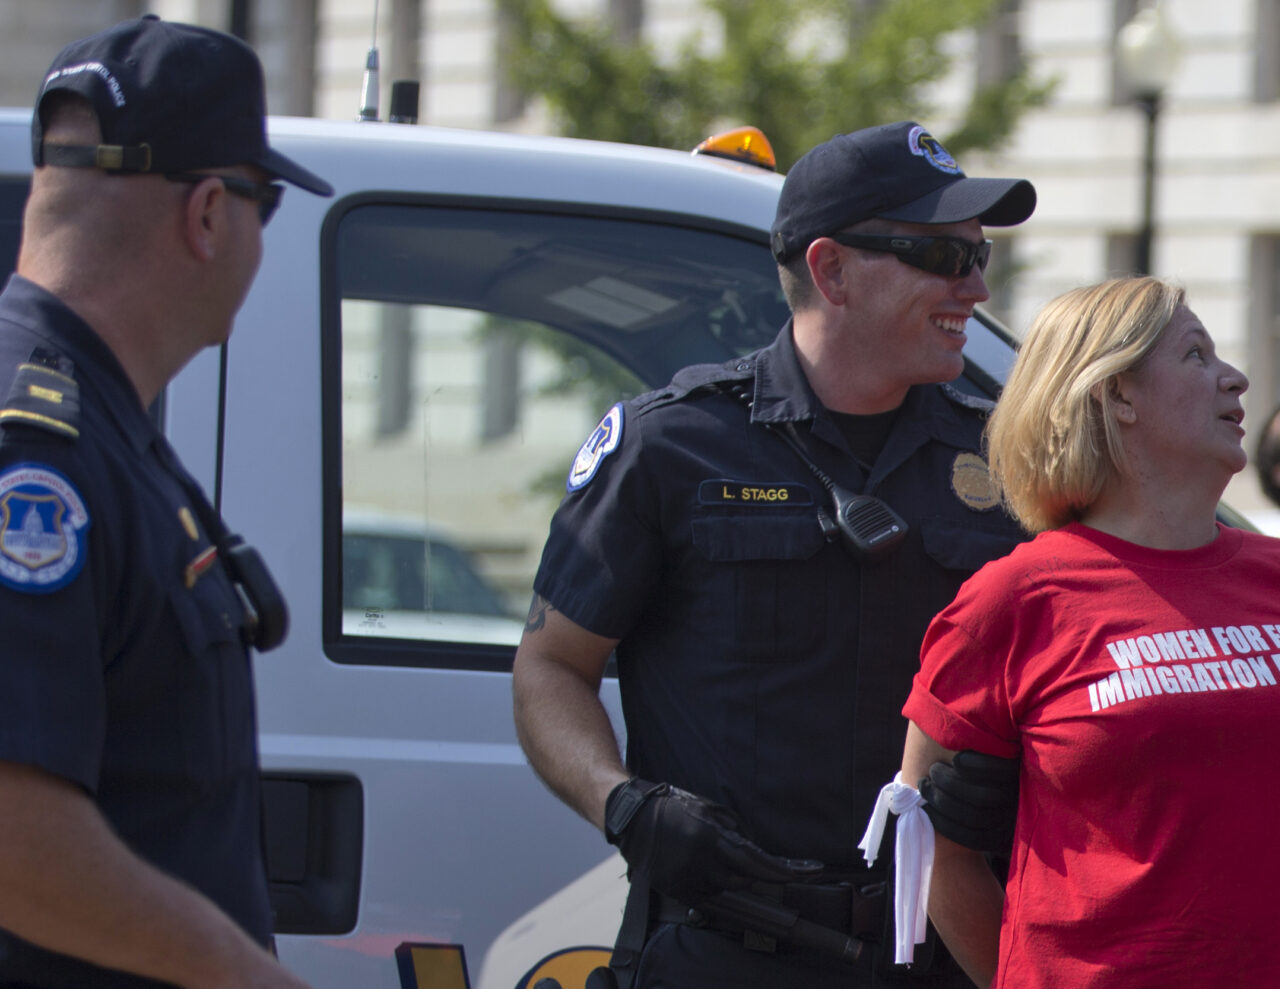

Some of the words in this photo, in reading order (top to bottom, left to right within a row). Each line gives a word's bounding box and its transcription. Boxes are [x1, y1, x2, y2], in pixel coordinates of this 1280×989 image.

[723, 485, 735, 499] L.
[741, 487, 789, 501] STAGG
[1106, 628, 1217, 669] WOMEN
[1211, 625, 1270, 656] FOR
[1087, 656, 1277, 713] IMMIGRATION
